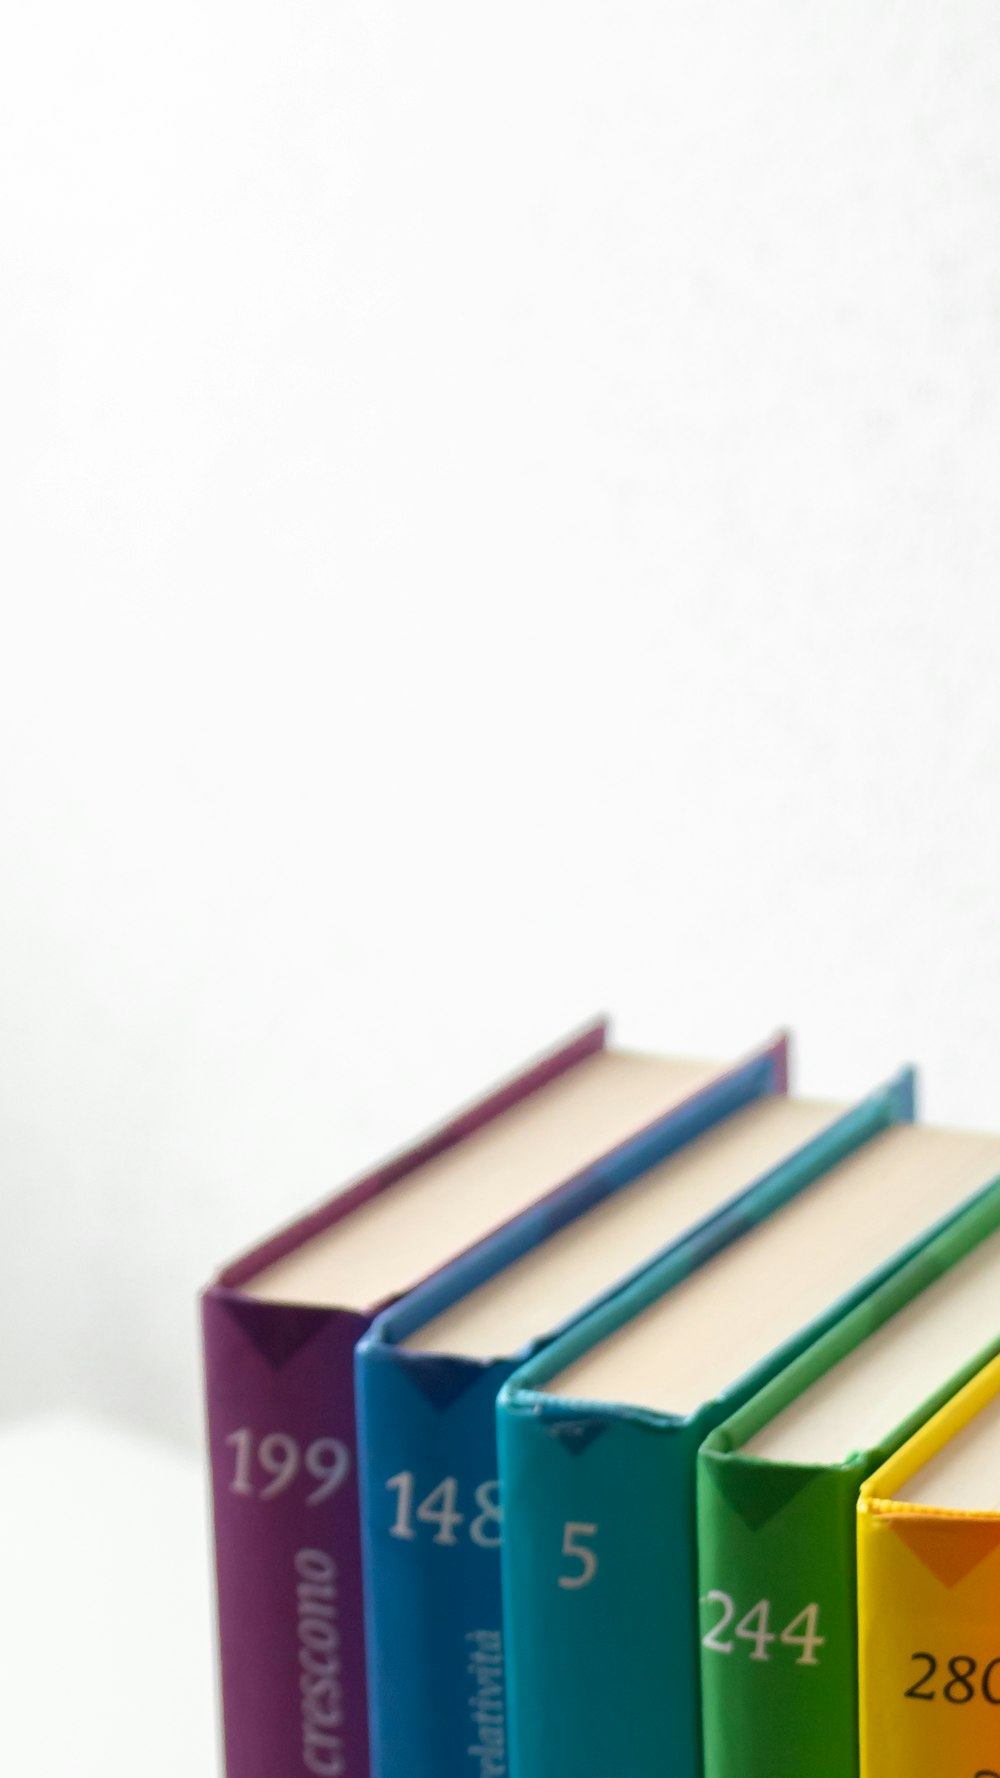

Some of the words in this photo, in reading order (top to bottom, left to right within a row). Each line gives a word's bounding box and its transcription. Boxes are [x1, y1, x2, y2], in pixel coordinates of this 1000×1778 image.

[224, 1426, 351, 1505] 199
[384, 1470, 505, 1549] 148
[557, 1521, 599, 1589] 5
[295, 1547, 346, 1778] crescono
[699, 1589, 826, 1666] 244
